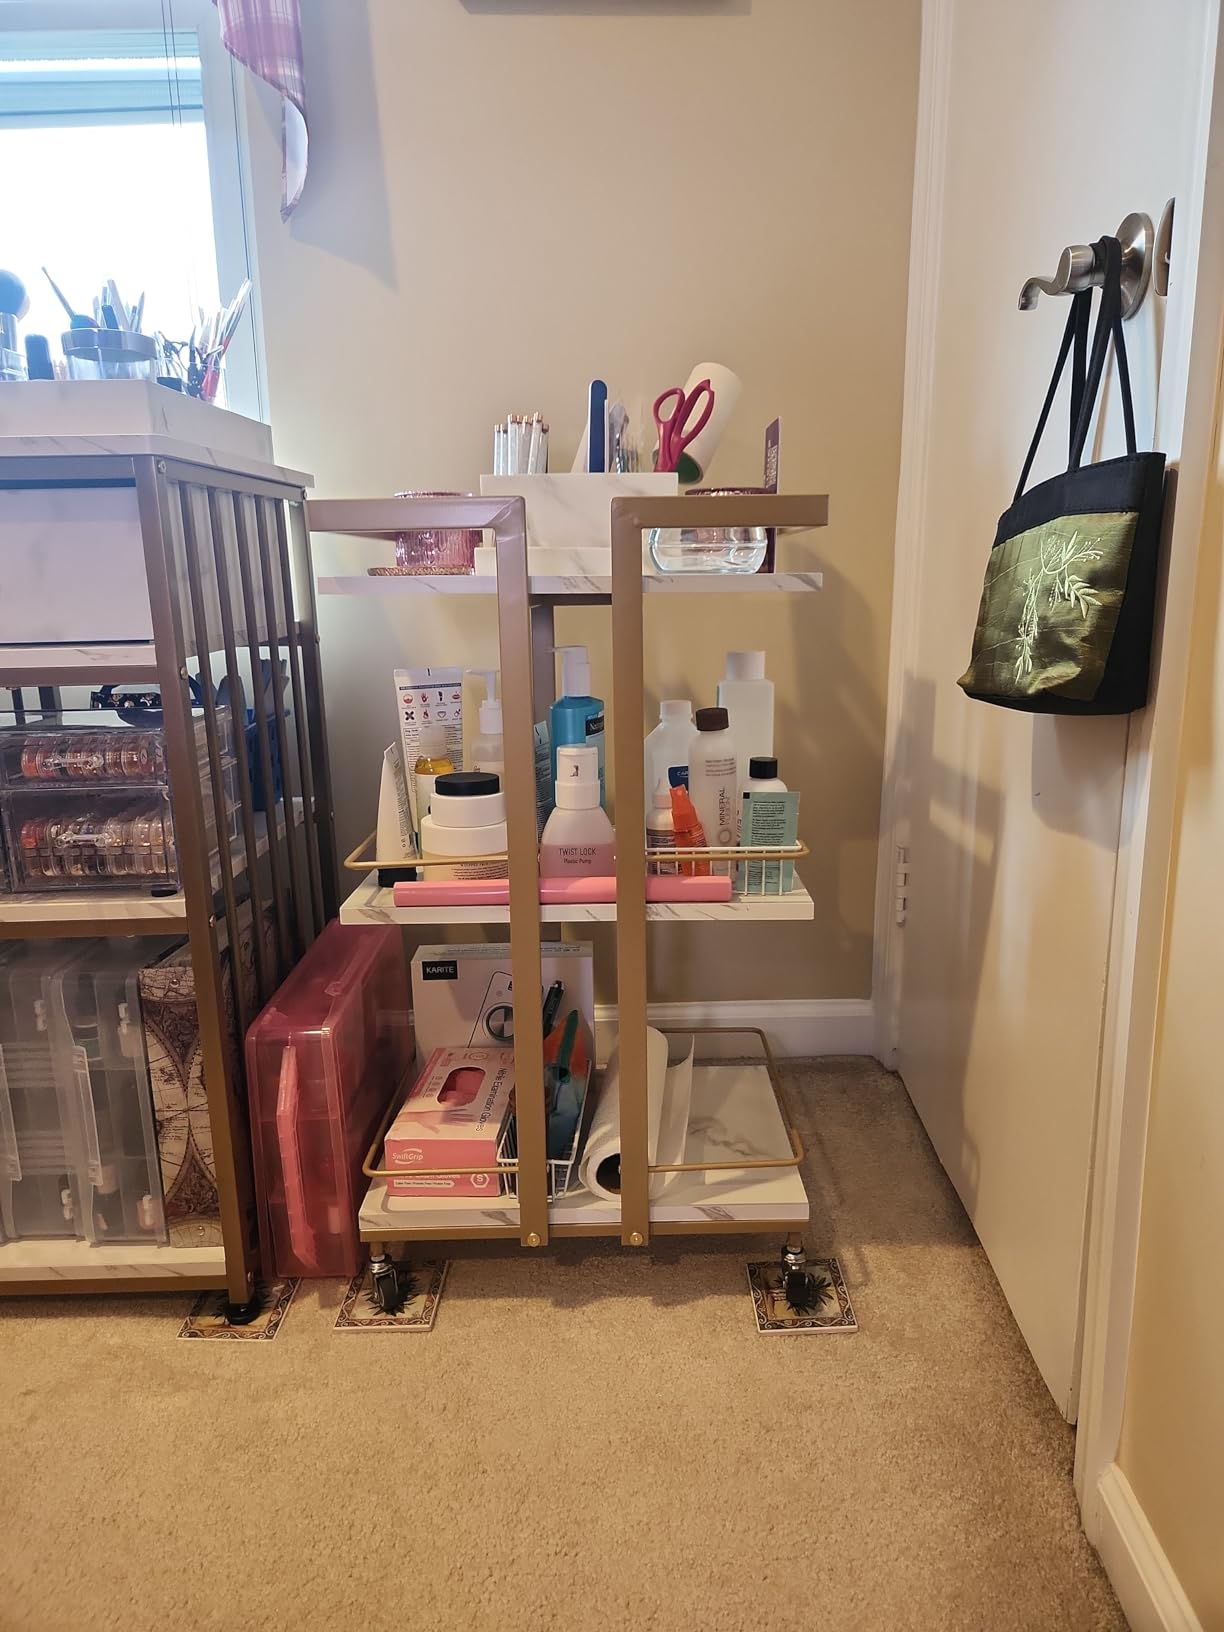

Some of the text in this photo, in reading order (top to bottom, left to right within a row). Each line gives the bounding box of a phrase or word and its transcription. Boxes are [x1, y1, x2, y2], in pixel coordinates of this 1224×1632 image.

[559, 848, 597, 856] TWIST LOCK
[426, 966, 455, 974] KARITE
[391, 1152, 424, 1161] SwiftGrip
